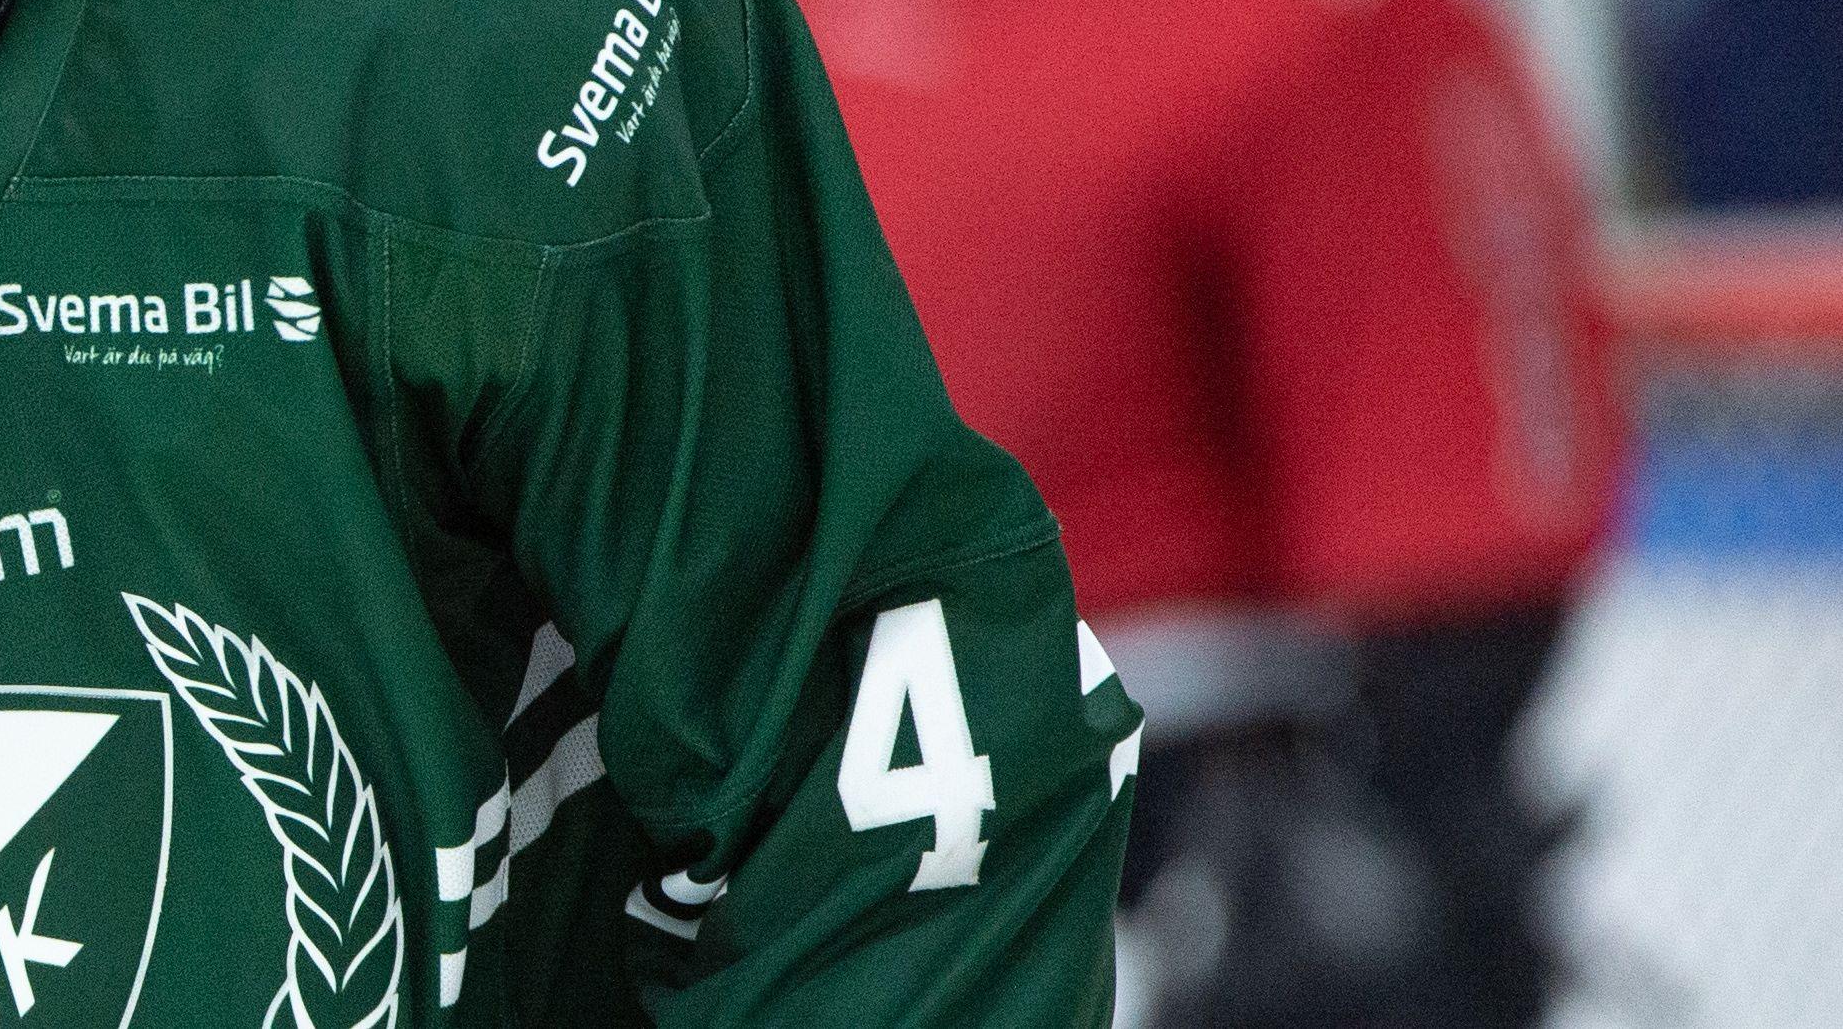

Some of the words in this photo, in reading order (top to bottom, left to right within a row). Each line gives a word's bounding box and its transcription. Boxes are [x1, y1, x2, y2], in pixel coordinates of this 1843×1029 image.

[537, 8, 649, 187] Svema
[616, 101, 645, 143] Vart
[184, 279, 255, 334] Bil
[63, 344, 100, 364] Vart
[102, 347, 125, 365] är
[127, 344, 153, 365] du
[158, 347, 178, 371] på
